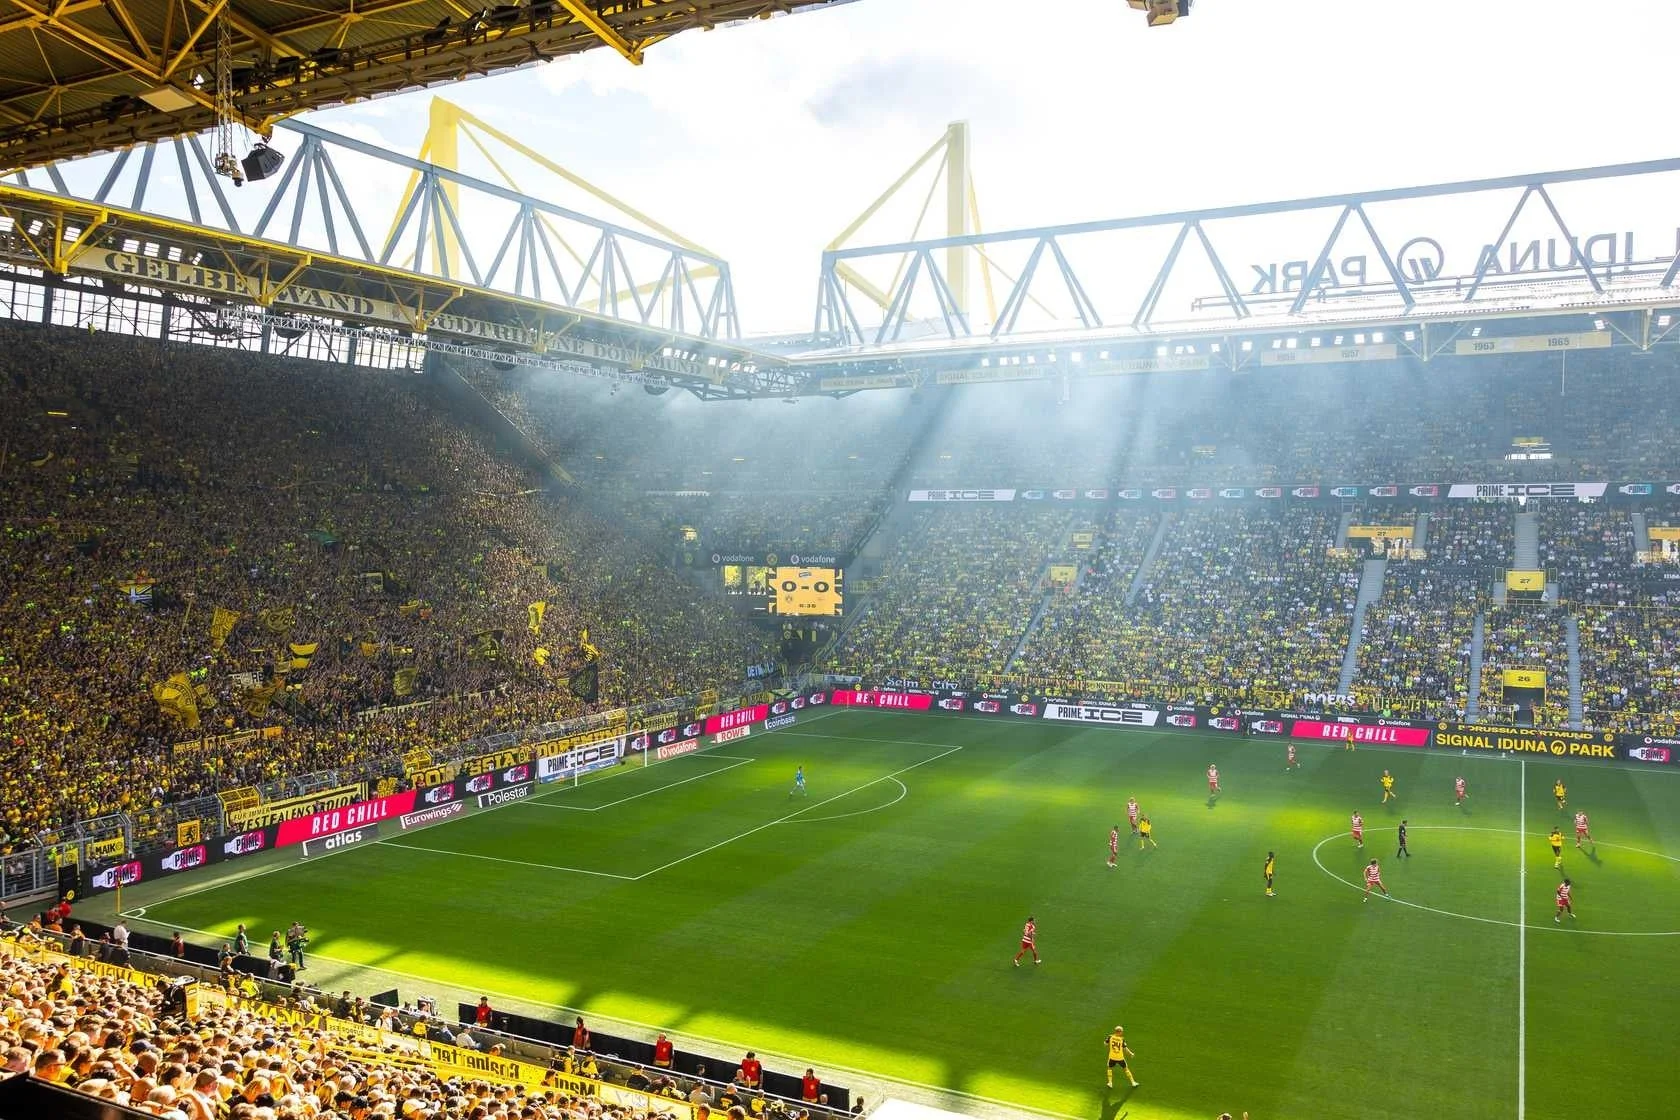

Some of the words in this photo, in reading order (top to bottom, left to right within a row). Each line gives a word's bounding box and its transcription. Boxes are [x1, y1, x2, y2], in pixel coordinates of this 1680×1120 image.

[104, 251, 248, 294] GELBE
[1476, 485, 1504, 497] PRIME
[1507, 484, 1576, 497] ICE
[801, 554, 836, 564] vodafone
[879, 694, 910, 707] CHILL
[1058, 706, 1083, 719] PRIME
[1084, 710, 1143, 724] ICE
[721, 727, 745, 742] ROWE
[1322, 725, 1349, 737] RED
[1355, 727, 1398, 742] CHILL
[1436, 733, 1494, 749] SIGNAL
[1497, 738, 1548, 753] IDUNA
[1569, 743, 1616, 758] PARK
[547, 755, 569, 774] PRIME
[488, 785, 529, 806] Polestar
[311, 812, 341, 835] RED
[347, 800, 388, 825] CHILL
[404, 806, 452, 827] Eurowings
[95, 843, 116, 854] MAIK
[325, 830, 362, 850] atlas
[174, 849, 200, 869] PRIME
